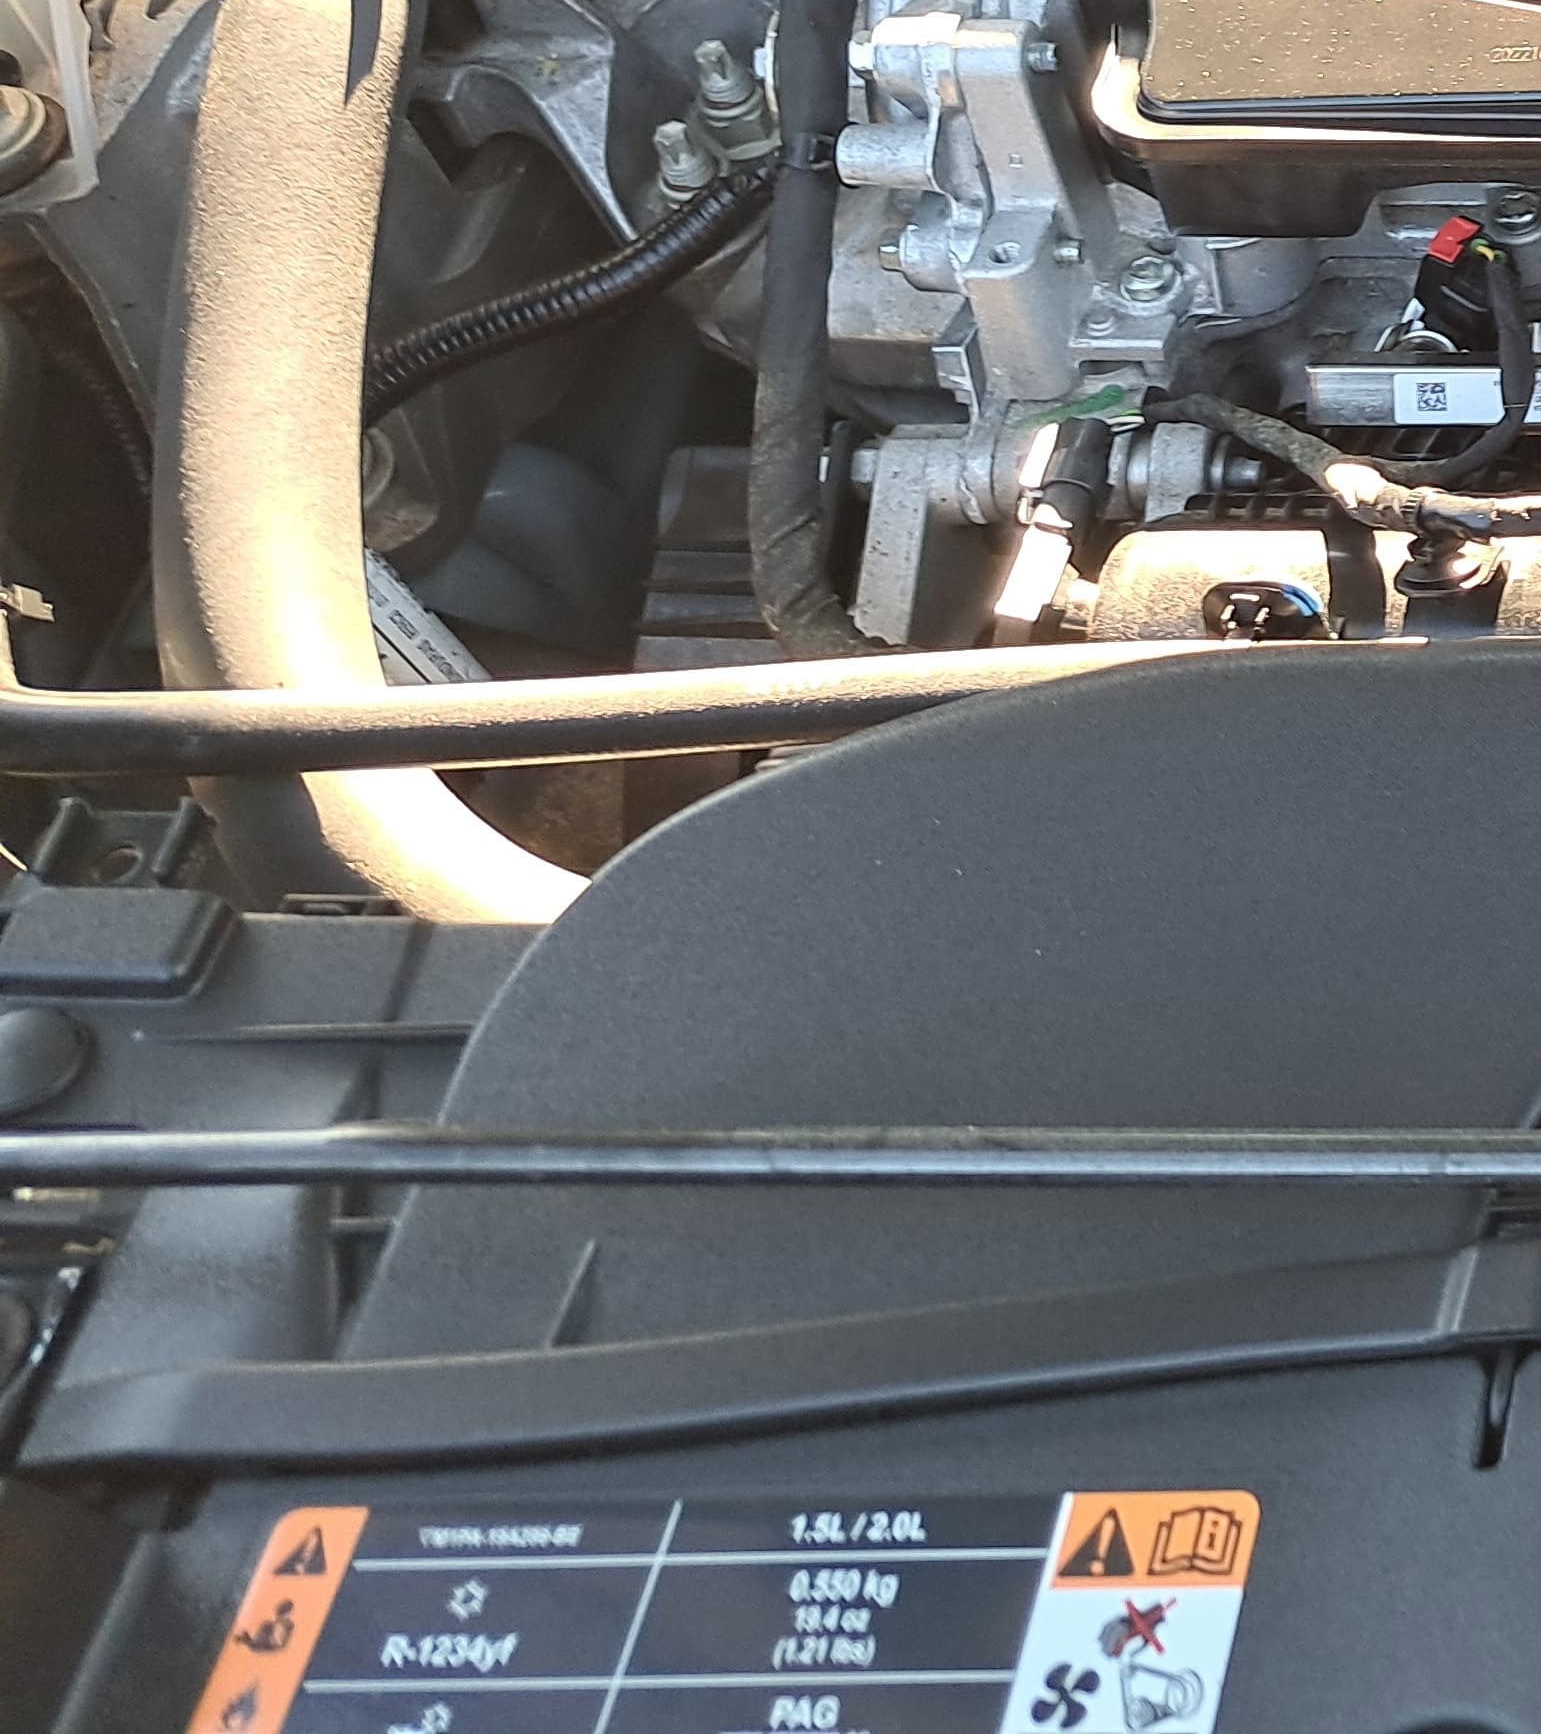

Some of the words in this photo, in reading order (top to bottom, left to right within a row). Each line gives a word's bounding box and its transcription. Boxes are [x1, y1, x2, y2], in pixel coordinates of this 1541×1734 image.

[792, 1513, 846, 1544] 1.5L
[850, 1513, 867, 1541] /
[866, 1511, 926, 1542] 2.0L
[789, 1569, 862, 1602] 0.550
[863, 1569, 899, 1608] kg
[380, 1632, 519, 1673] R-1234yf
[769, 1695, 841, 1730] PAG
